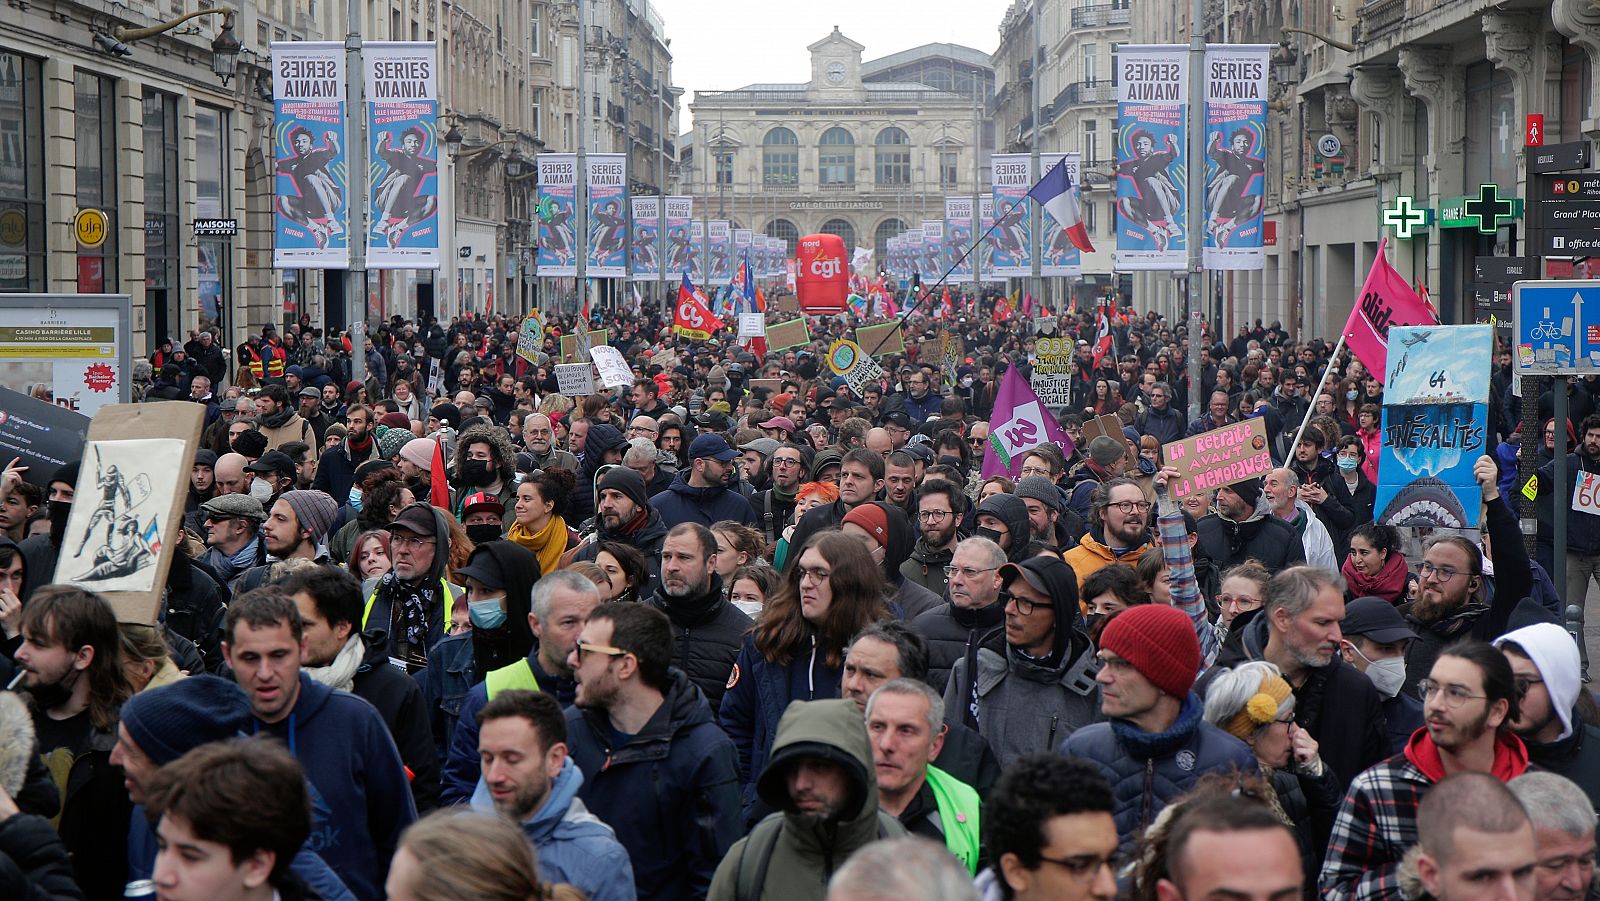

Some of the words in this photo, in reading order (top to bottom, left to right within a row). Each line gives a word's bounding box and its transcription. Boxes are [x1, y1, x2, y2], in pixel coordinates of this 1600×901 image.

[374, 62, 430, 79] SERIES
[1211, 62, 1262, 80] SERIES
[375, 81, 428, 98] MANIA
[1210, 82, 1259, 98] MANIA
[592, 165, 622, 174] SERIES
[592, 176, 620, 184] MANIA
[1554, 210, 1580, 218] Grand'
[1568, 239, 1590, 250] office
[811, 256, 841, 278] cgt
[1033, 379, 1070, 388] INJUSTICE
[1430, 370, 1446, 388] 64
[1170, 443, 1185, 460] LA
[1189, 446, 1243, 472] AVANT
[1174, 480, 1192, 497] LA
